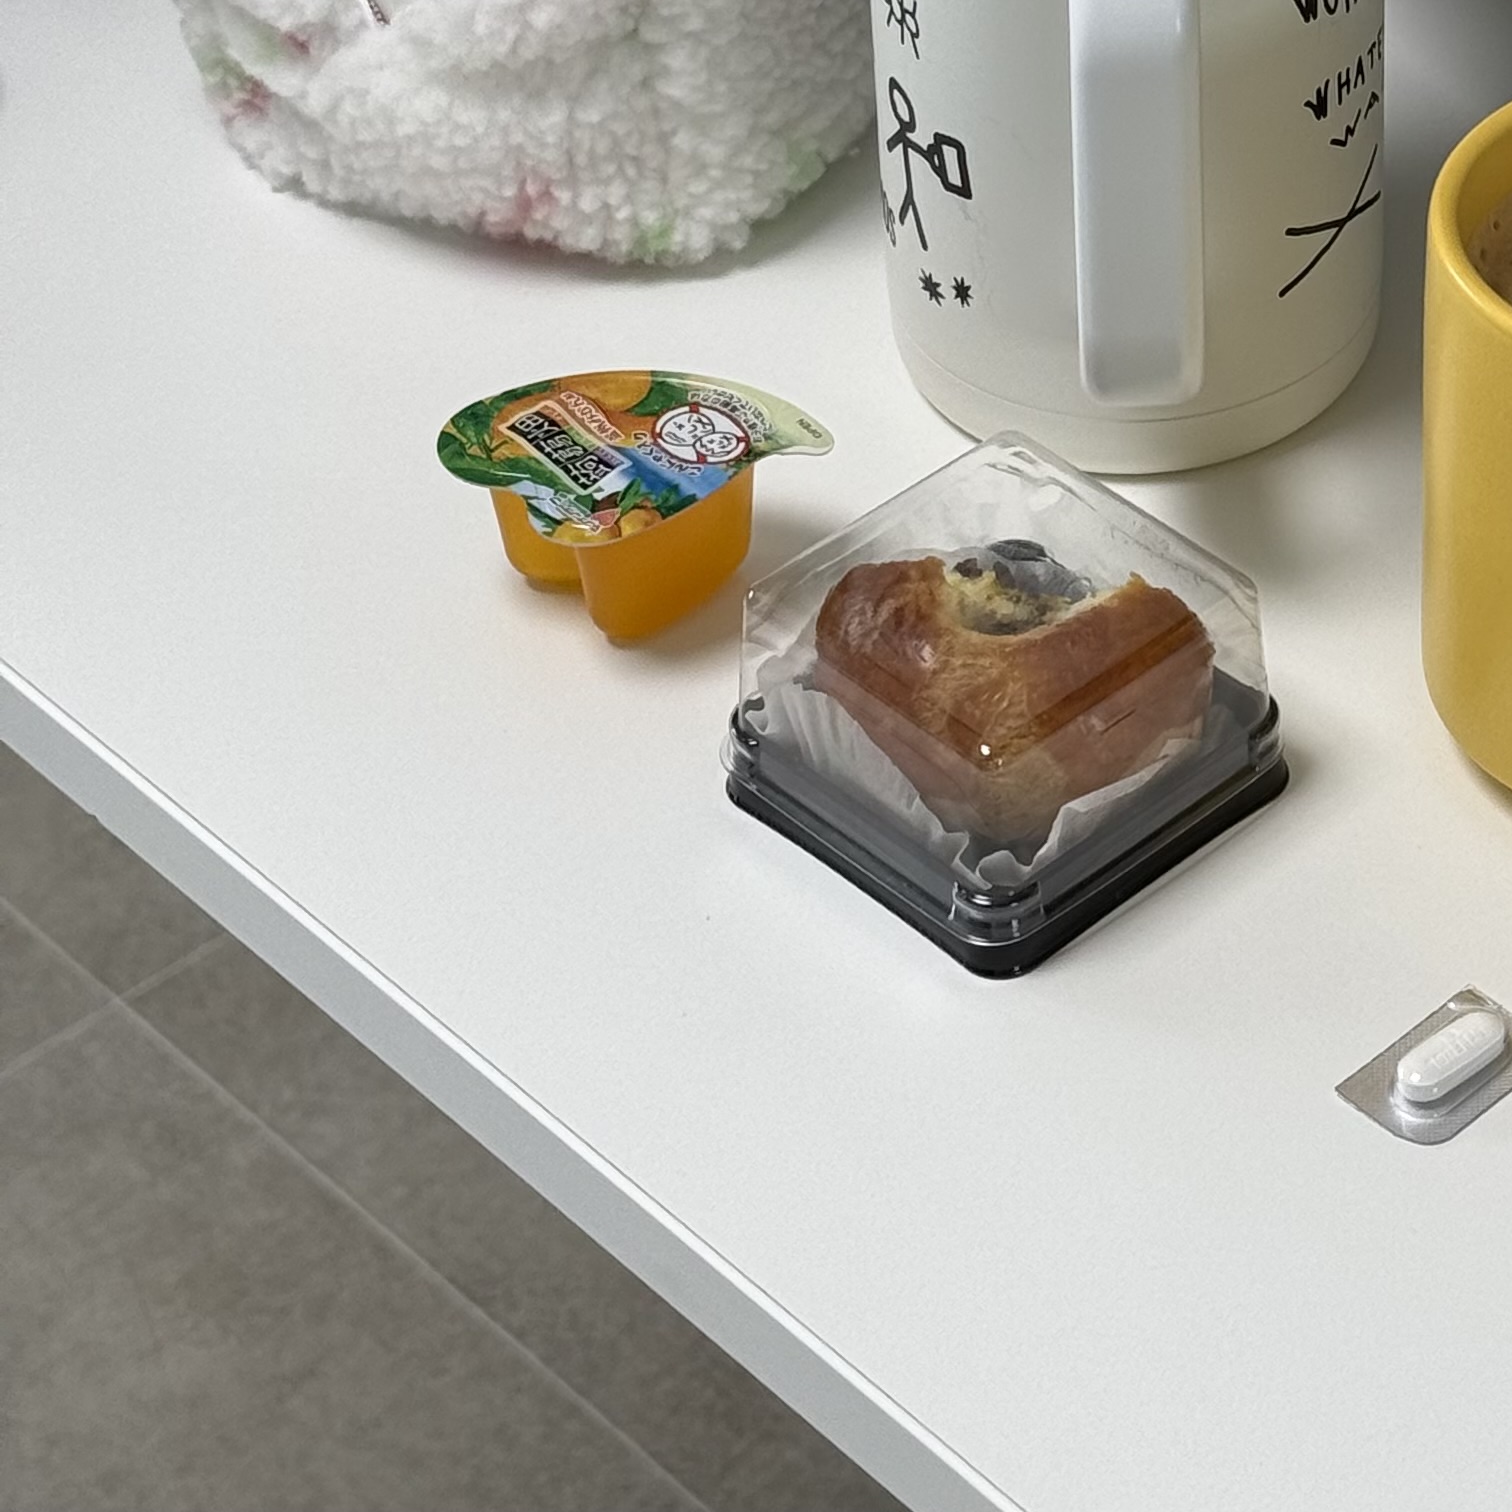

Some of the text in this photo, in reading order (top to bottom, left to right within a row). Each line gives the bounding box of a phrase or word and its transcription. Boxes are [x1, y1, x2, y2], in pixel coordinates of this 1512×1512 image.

[514, 412, 612, 488] 蒟蒻畑
[798, 417, 824, 440] OPEN
